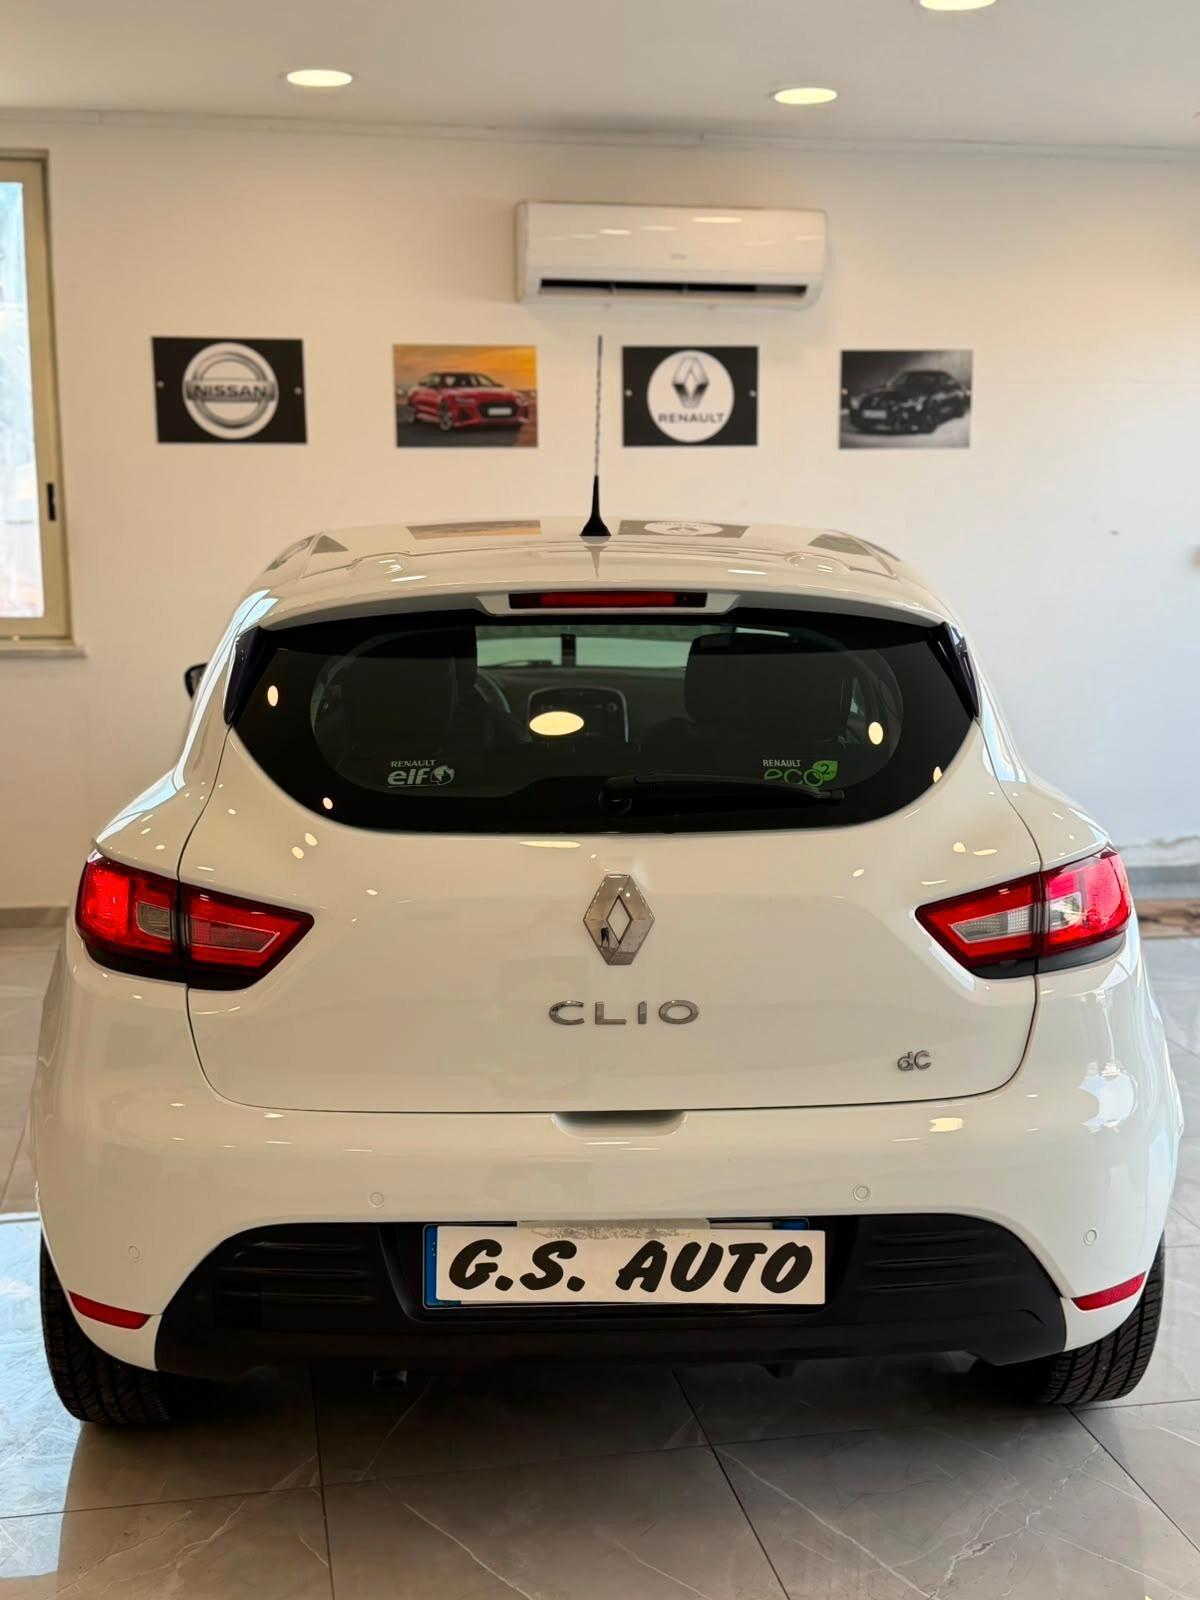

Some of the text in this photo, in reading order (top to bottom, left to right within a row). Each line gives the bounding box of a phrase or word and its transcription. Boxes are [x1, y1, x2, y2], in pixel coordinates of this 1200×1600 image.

[193, 385, 267, 398] NISSAN
[658, 412, 725, 424] RENAULT
[390, 759, 436, 768] RENAULT
[762, 759, 801, 768] RENAULT
[548, 999, 700, 1026] CLIO
[448, 1238, 814, 1294] G.S. AUTO
